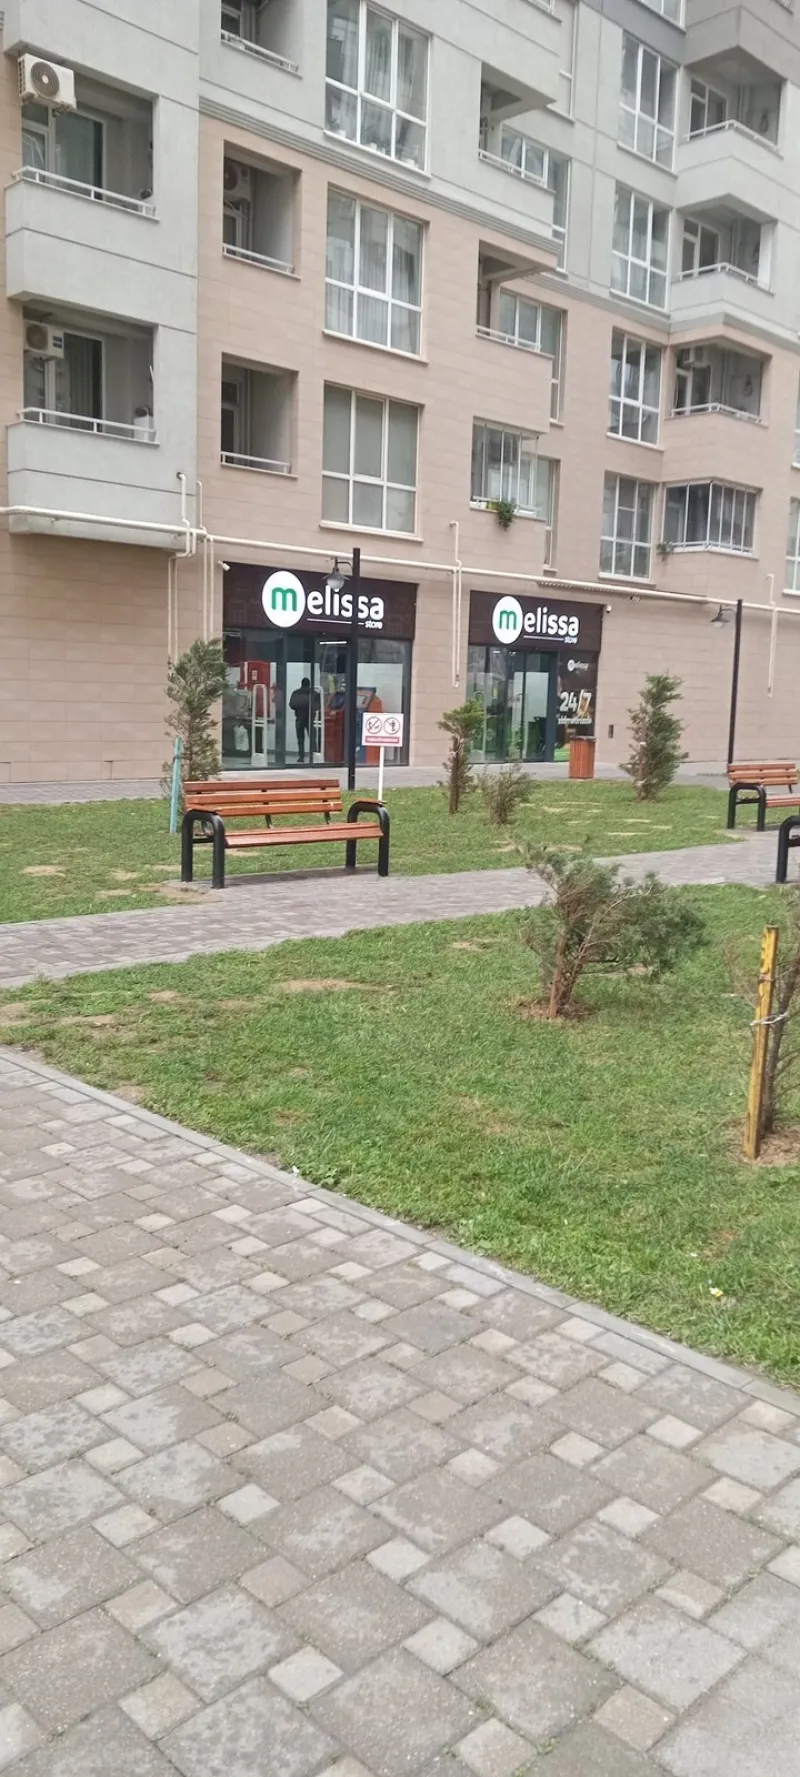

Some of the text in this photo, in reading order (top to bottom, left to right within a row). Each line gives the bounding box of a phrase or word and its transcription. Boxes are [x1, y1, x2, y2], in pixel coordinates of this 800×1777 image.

[269, 583, 385, 621] melissa
[365, 620, 383, 629] store
[498, 606, 580, 637] melissa
[559, 689, 592, 717] 24/7
